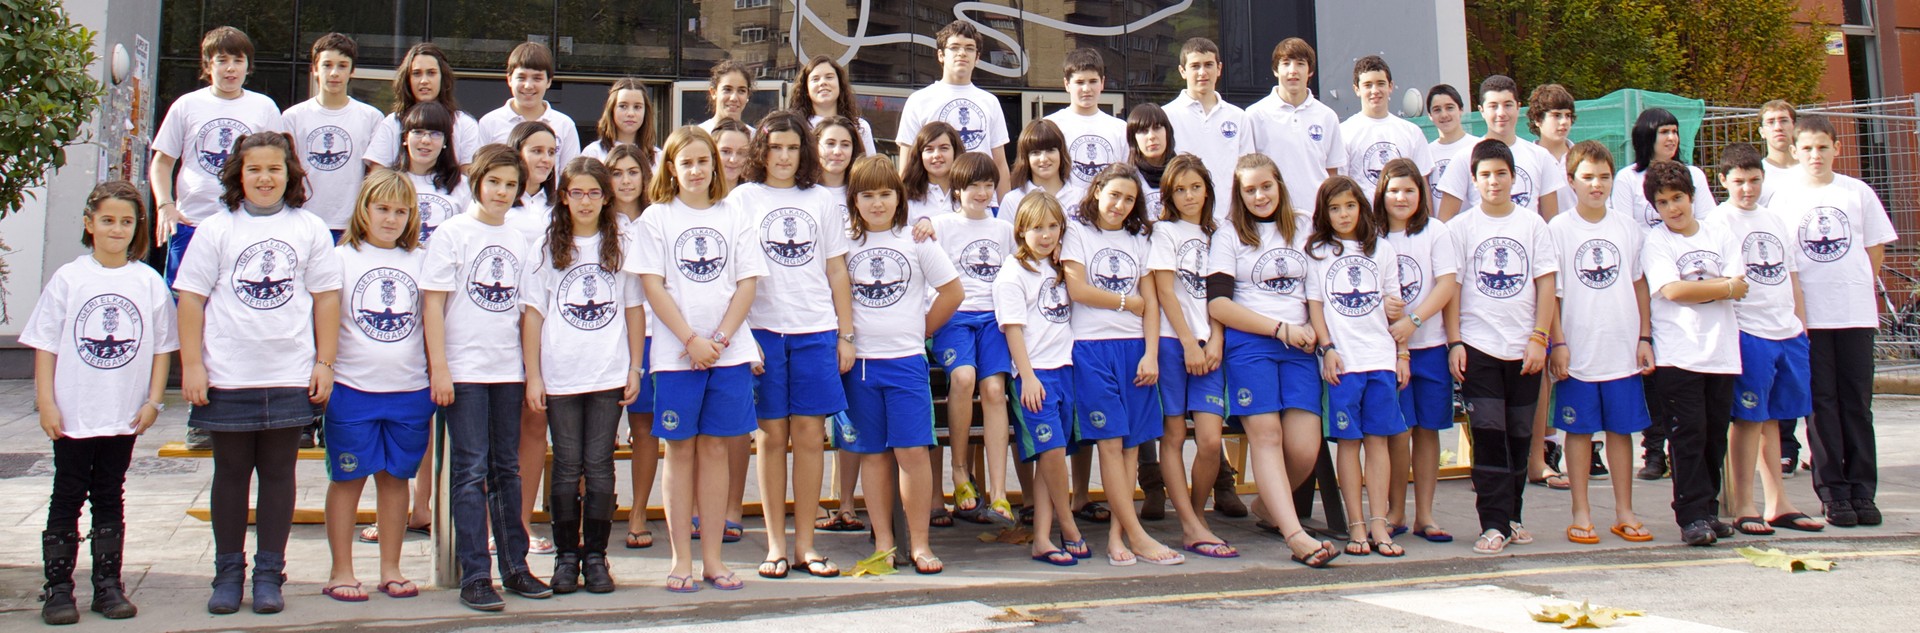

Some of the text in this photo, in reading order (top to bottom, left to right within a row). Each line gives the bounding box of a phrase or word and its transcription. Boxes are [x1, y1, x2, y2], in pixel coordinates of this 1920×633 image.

[761, 209, 815, 230] IGERI ELKARTEA
[691, 229, 724, 246] ELKARTEA
[238, 246, 258, 267] IGERI
[1492, 239, 1526, 260] ELKARTEA
[1808, 249, 1843, 261] BERGARA
[773, 253, 810, 265] BERGARA
[866, 249, 907, 268] ELKARTEA
[1254, 249, 1306, 273] IGERI ELKARTEA
[685, 268, 720, 281] BERGARA
[1327, 257, 1379, 280] IGERI ELKARTEA
[355, 269, 416, 297] IGERI ELKARTEA
[561, 266, 615, 292] IGERI ELKARTEA
[1479, 284, 1519, 296] BERGARA
[243, 293, 288, 308] BERGARA
[476, 295, 515, 310] BERGARA
[857, 293, 900, 306] BERGARA
[100, 296, 139, 324] ELKARTEA
[1337, 302, 1376, 315] BERGARA
[570, 315, 609, 329] BERGARA
[364, 324, 409, 340] BERGARA
[84, 352, 130, 367] BERGARA
